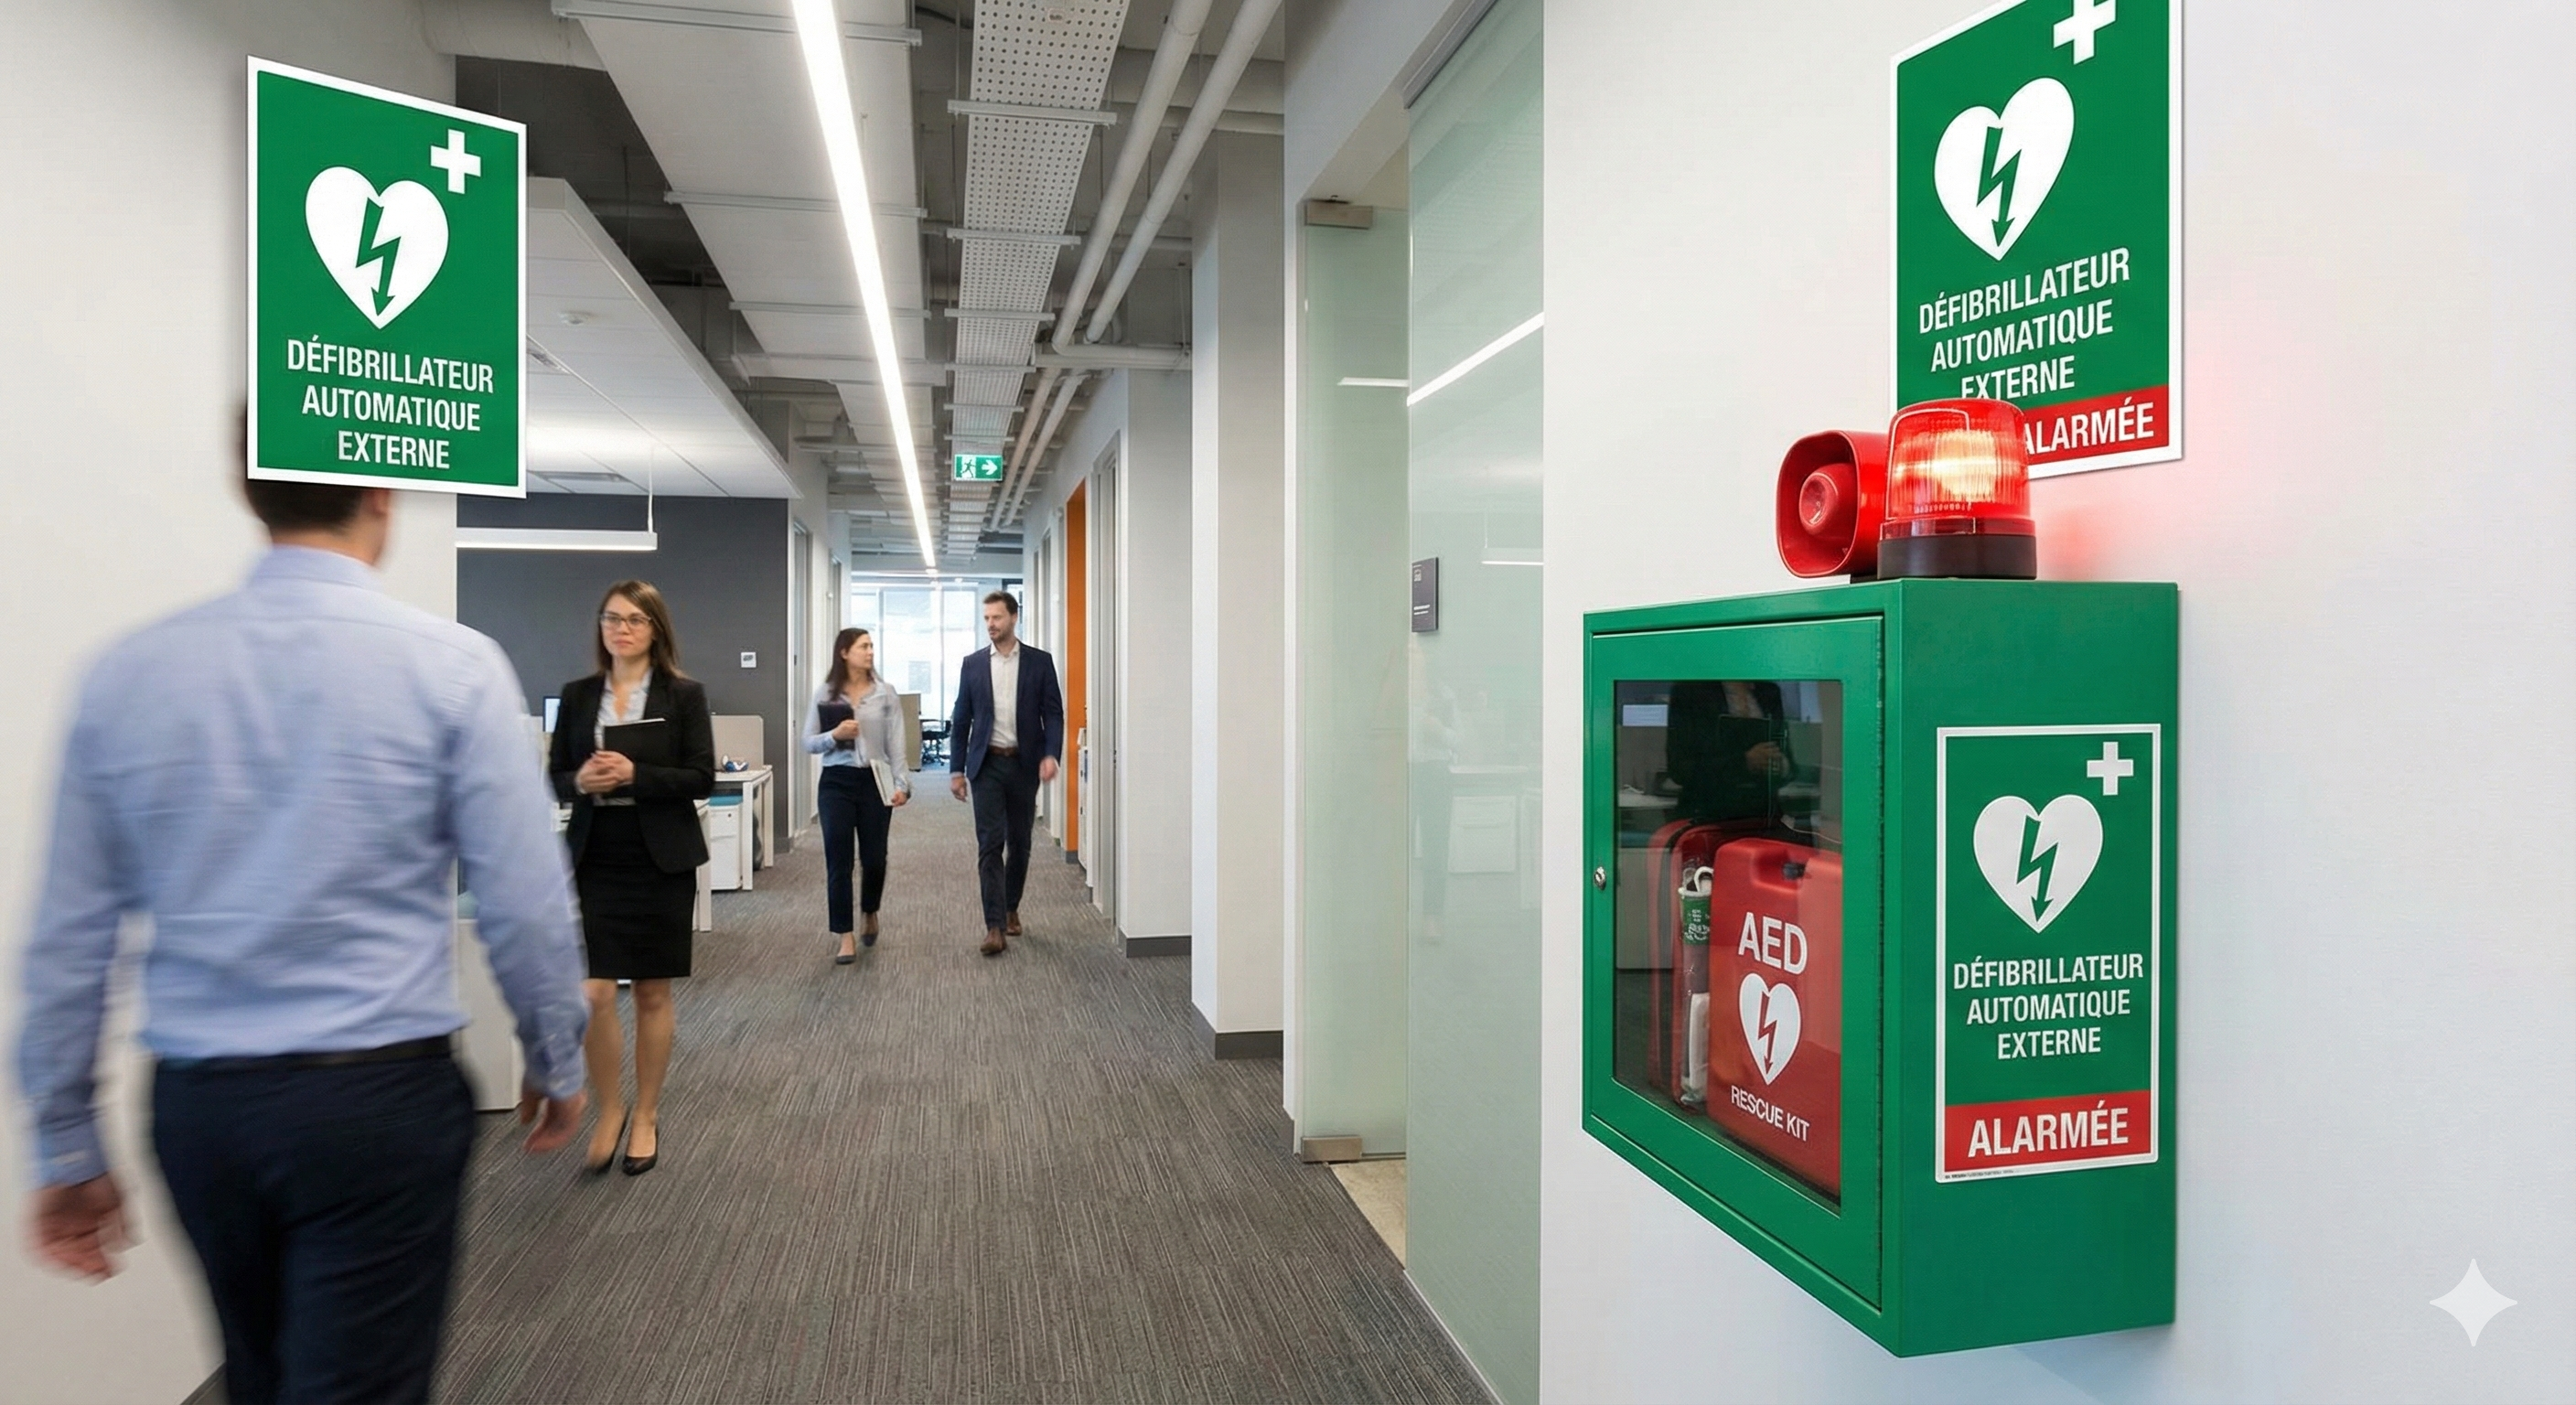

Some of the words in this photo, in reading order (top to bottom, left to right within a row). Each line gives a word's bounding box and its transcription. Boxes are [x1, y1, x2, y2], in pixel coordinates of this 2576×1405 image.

[1919, 247, 2131, 335] DÉFIBRILLATEUR
[287, 334, 494, 393] DÉFIBRILLATEUR
[1930, 298, 2114, 372] AUTOMATIQUE
[302, 384, 481, 433] AUTOMATIQUE
[338, 430, 451, 469] EXTERNE
[1738, 911, 1809, 975] AED
[1953, 953, 2144, 990] DÉFIBRILLATEUR
[1966, 990, 2131, 1025] AUTOMATIQUE
[1997, 1026, 2101, 1060] EXTERNE
[1731, 1085, 1784, 1130] RESCUE
[1787, 1112, 1810, 1142] KIT
[1967, 1099, 2129, 1159] ALARMÉE
